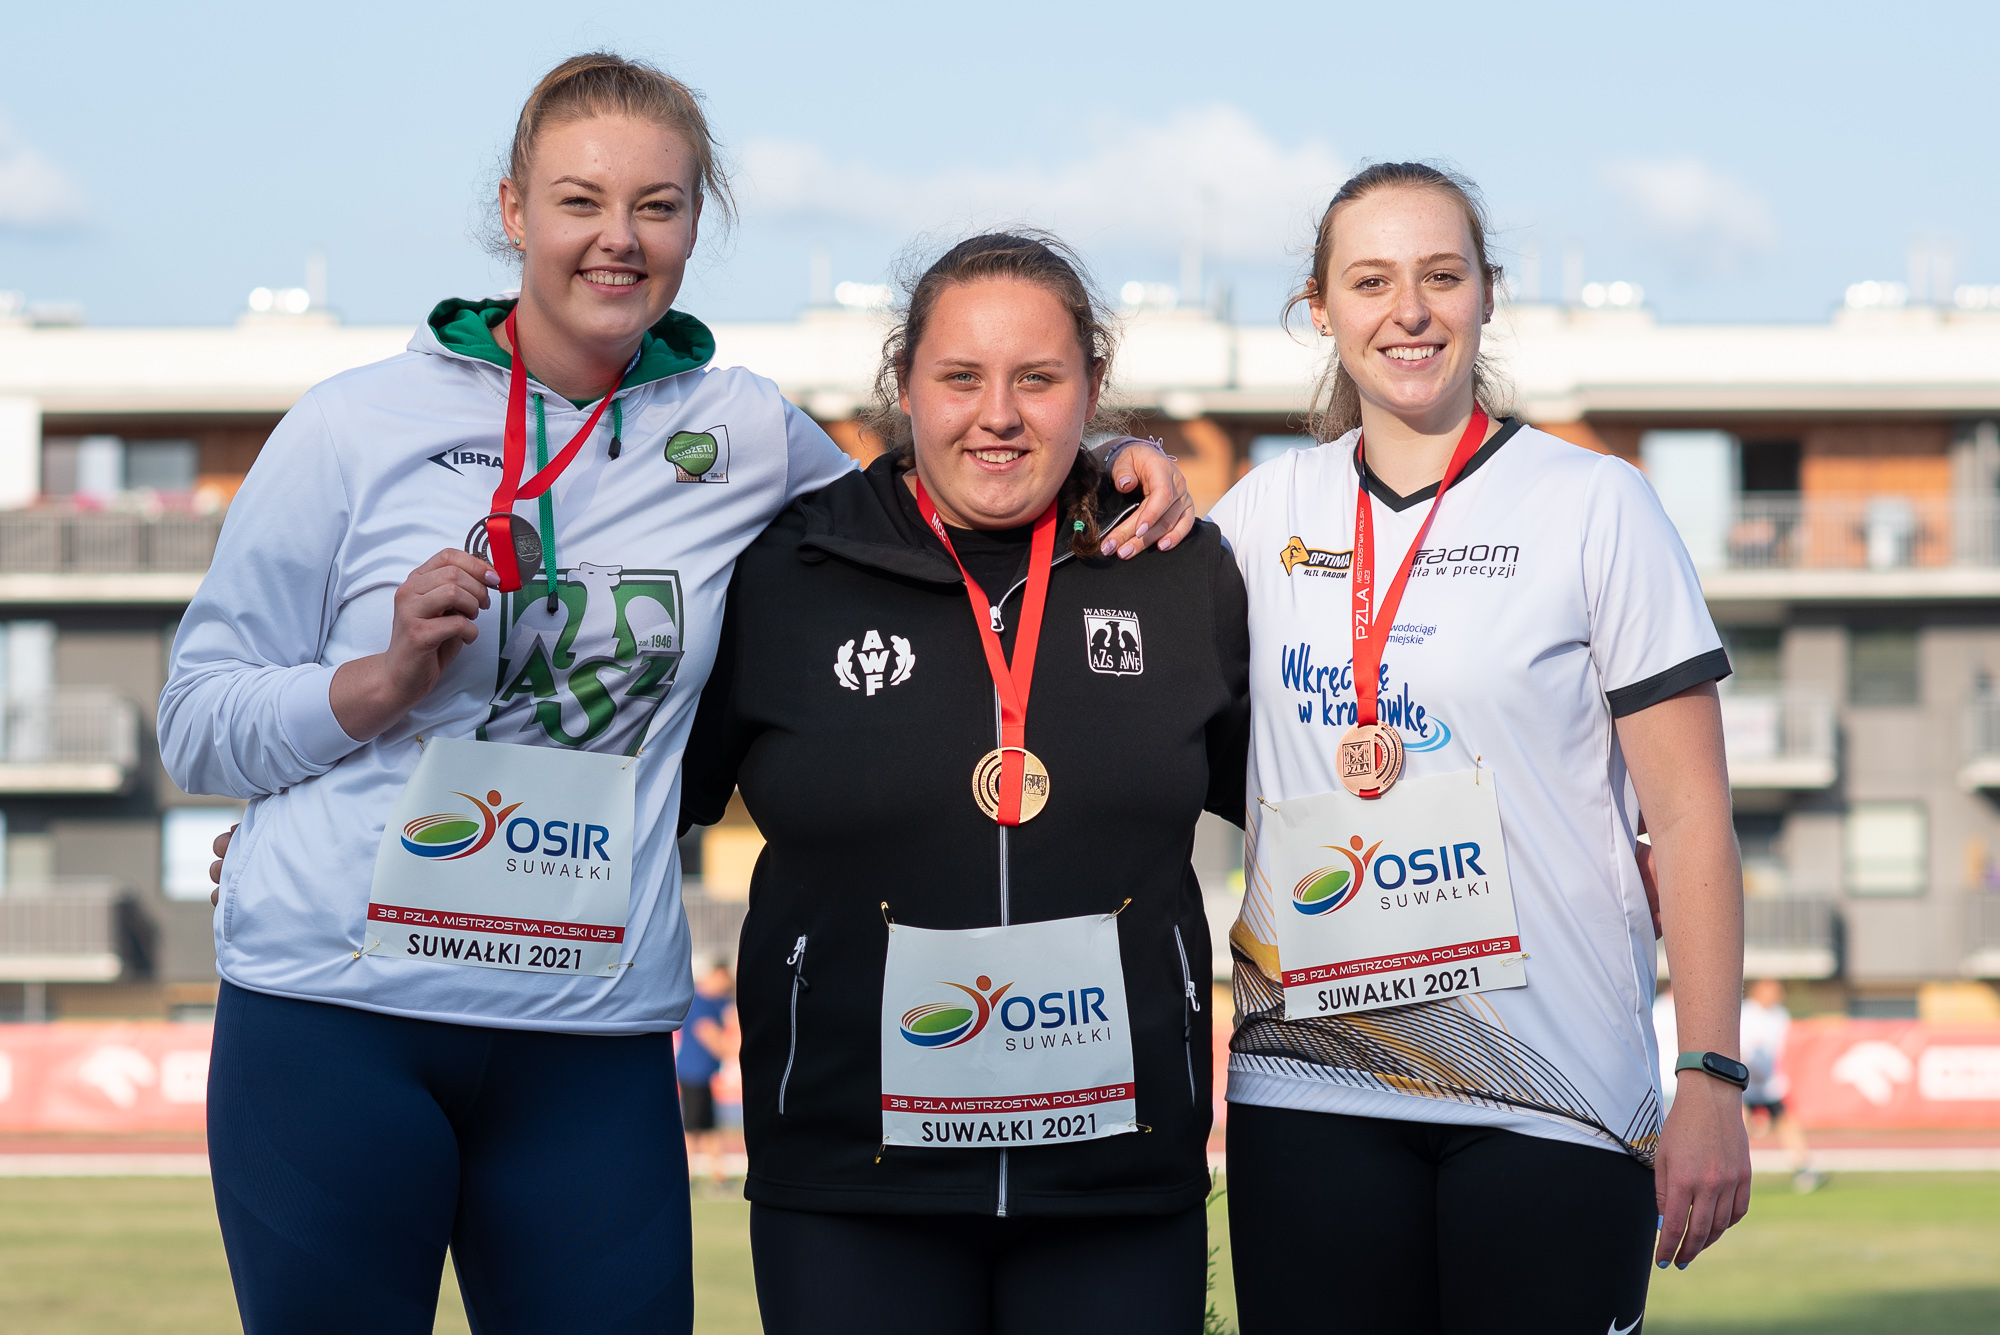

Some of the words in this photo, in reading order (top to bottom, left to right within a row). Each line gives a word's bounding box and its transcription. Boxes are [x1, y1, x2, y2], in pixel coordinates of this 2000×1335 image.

[1309, 552, 1351, 568] OPTIMA
[1356, 533, 1364, 584] MISTRZOSTWA
[1436, 566, 1448, 575] w
[1453, 564, 1517, 579] precyzji
[1321, 570, 1347, 579] RADOM
[1083, 608, 1138, 619] WARSZAWA
[1356, 588, 1370, 640] PZLA
[651, 634, 672, 649] 1946
[1387, 633, 1424, 646] miejskie
[1390, 622, 1437, 636] wodociągi
[857, 629, 890, 696] AWF
[1093, 649, 1114, 669] AZS
[1120, 650, 1140, 671] AWF
[1298, 700, 1312, 724] w
[1322, 682, 1428, 738] kraówkę
[506, 817, 611, 862] OSIR
[506, 858, 611, 881] SUWAŁKI
[1373, 841, 1487, 890] OSIR
[1380, 881, 1490, 911] SUWAŁKI
[377, 908, 400, 920] 38.
[403, 911, 440, 924] PZLA
[442, 916, 540, 934] MISTRZOSTWA
[543, 925, 588, 938] POLSKI
[590, 929, 616, 940] U23
[406, 933, 521, 965] SUWAŁKI
[528, 945, 582, 970] 2021
[1290, 973, 1309, 984] 38.
[1310, 968, 1338, 981] PZLA
[1339, 953, 1430, 976] MISTRZOSTWA
[1432, 944, 1480, 961] POLSKI
[1482, 940, 1511, 953] U23
[1317, 977, 1417, 1012] SUWAŁKI
[1423, 966, 1482, 997] 2021
[1000, 986, 1109, 1032] OSIR
[1005, 1027, 1111, 1052] SUWAŁKI
[890, 1099, 911, 1109] 38.
[914, 1100, 948, 1110] PZLA
[951, 1098, 1050, 1110] MISTRZOSTWA
[1053, 1091, 1098, 1105] POLSKI
[1100, 1087, 1126, 1099] U23
[921, 1119, 1033, 1143] SUWAŁKI
[1042, 1112, 1097, 1140] 2021
